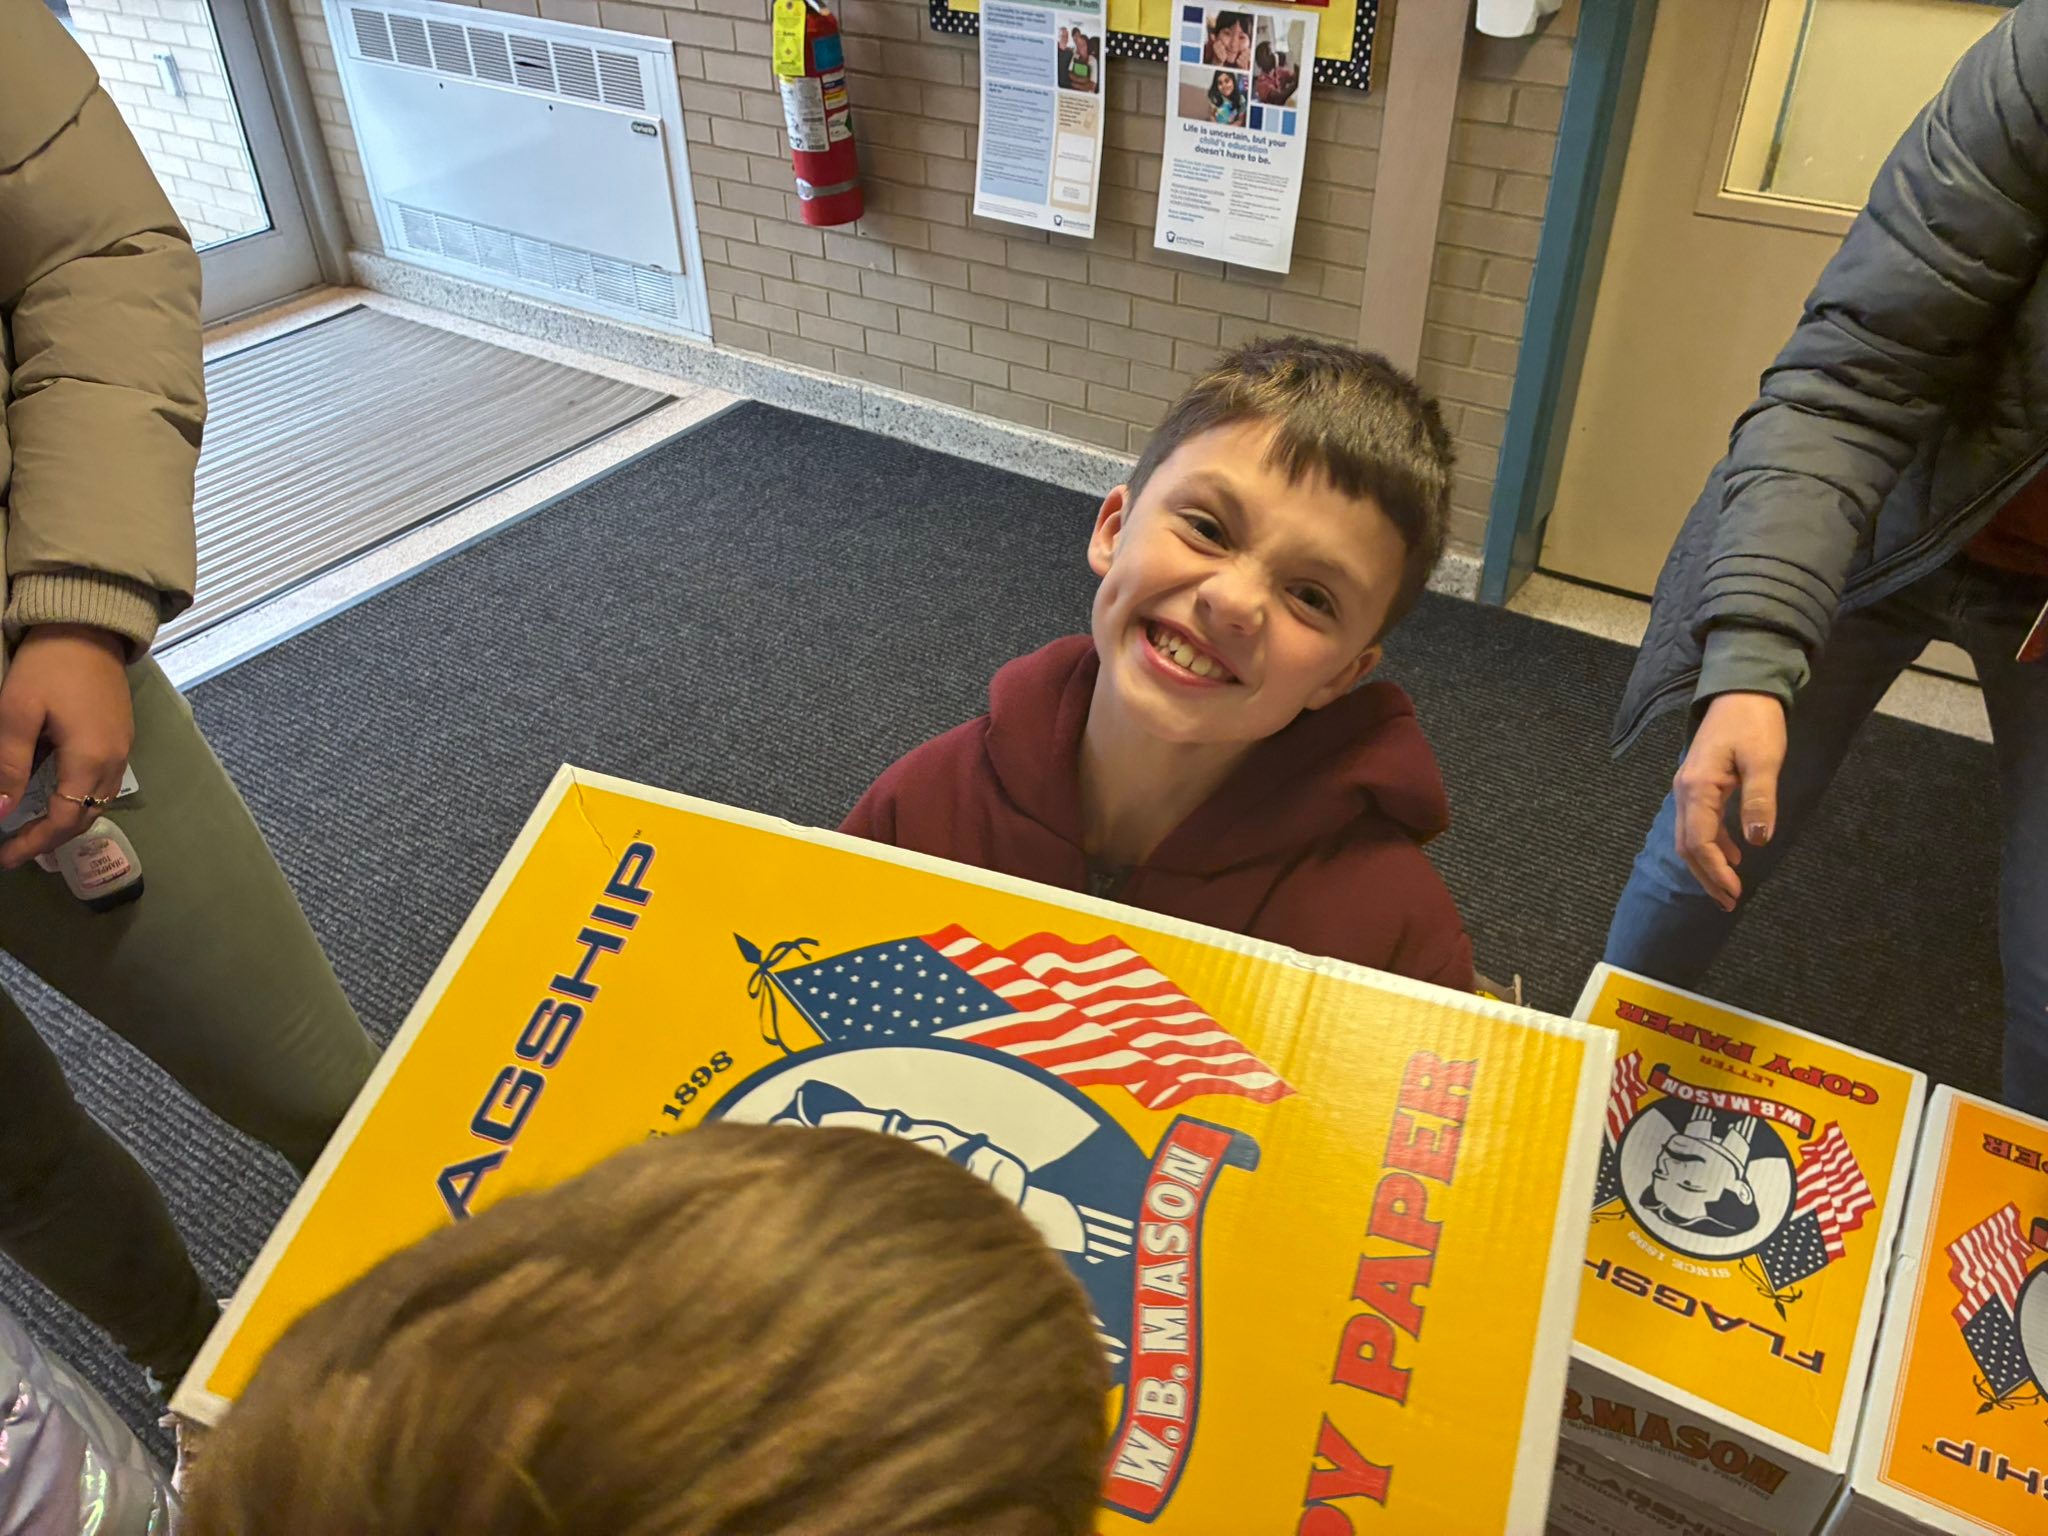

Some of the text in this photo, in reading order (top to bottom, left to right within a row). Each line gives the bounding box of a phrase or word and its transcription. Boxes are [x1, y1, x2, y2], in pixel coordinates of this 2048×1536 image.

[1183, 123, 1287, 147] Life is uncertain, but your
[1195, 144, 1271, 165] doesn't have to be.
[1199, 136, 1269, 154] child's education
[435, 841, 657, 1224] AGSHIP
[1616, 999, 1879, 1104] COPY PAPER
[661, 1050, 735, 1121] 1898
[1700, 1055, 1775, 1088] LETTER
[1332, 1050, 1479, 1407] PAPER
[1672, 1259, 1731, 1279] SINCE
[1583, 1257, 1827, 1375] FLAGSH
[1562, 1387, 1790, 1495] B.MASON
